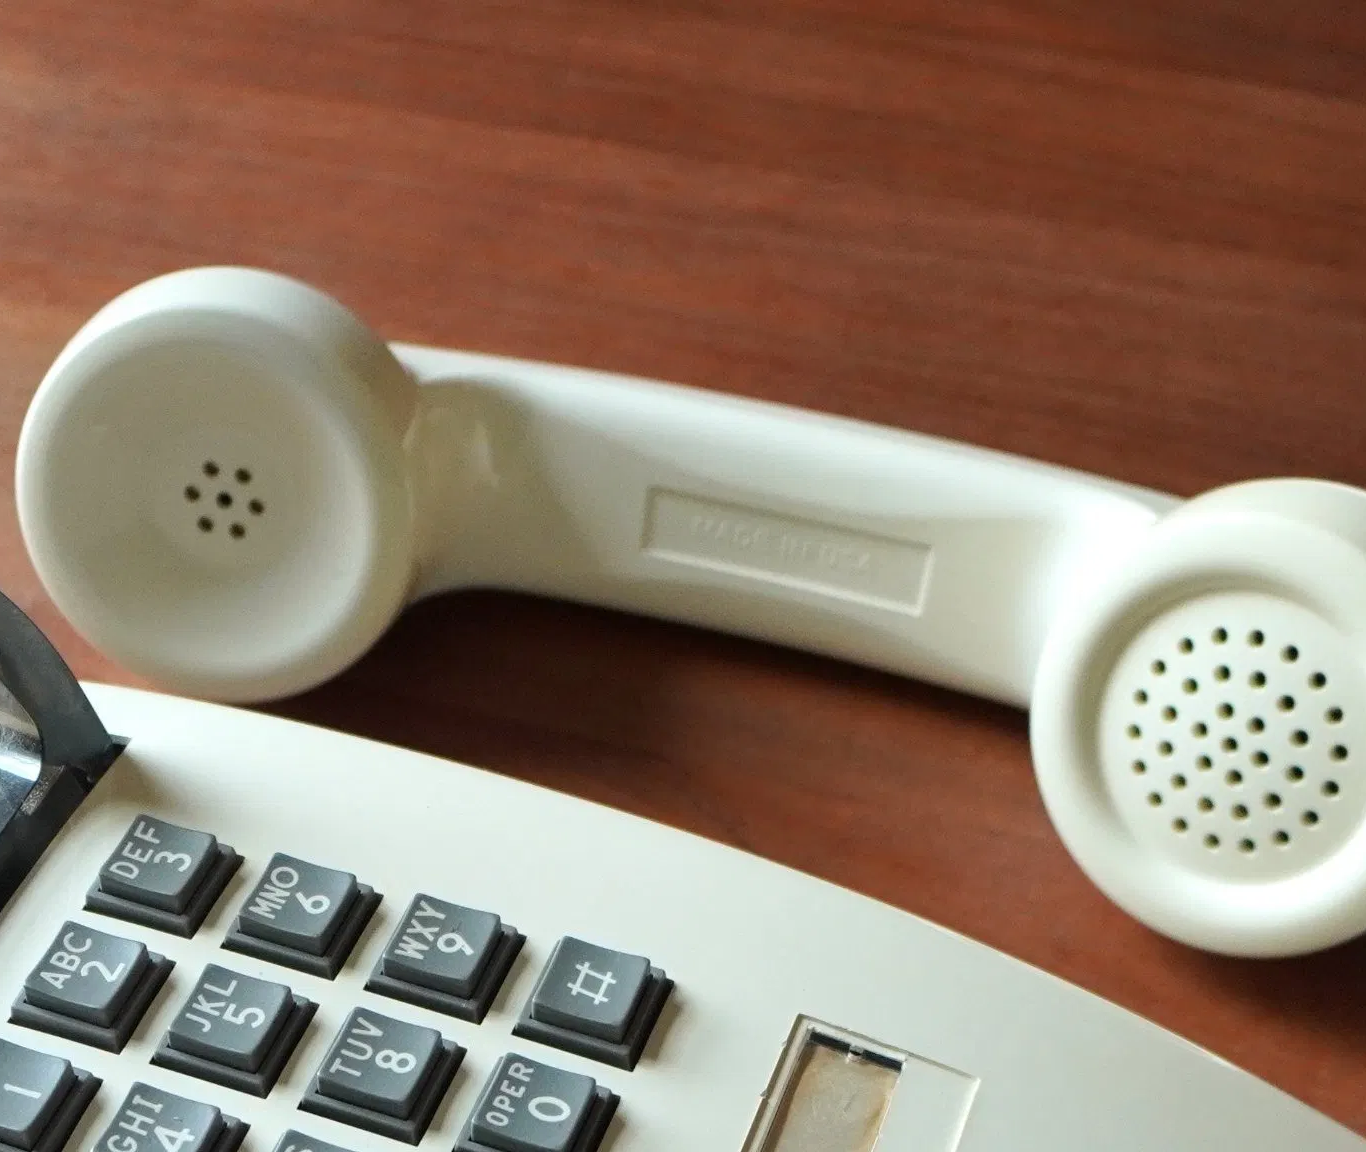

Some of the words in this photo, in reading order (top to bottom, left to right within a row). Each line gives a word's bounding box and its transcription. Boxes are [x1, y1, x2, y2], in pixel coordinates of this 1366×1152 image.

[109, 821, 162, 881] DEF
[153, 849, 193, 873] 3
[248, 866, 301, 920] MNO
[295, 891, 332, 916] 6
[394, 900, 447, 961] WXY
[436, 931, 475, 957] 9
[40, 931, 93, 990] ABC
[80, 961, 126, 983] 2
[566, 961, 618, 1005] #
[185, 979, 238, 1033] JKL
[222, 1007, 266, 1029] 5
[330, 1017, 385, 1078] TUV
[374, 1048, 418, 1075] 8
[486, 1062, 535, 1127] OPER
[527, 1095, 572, 1123] 0
